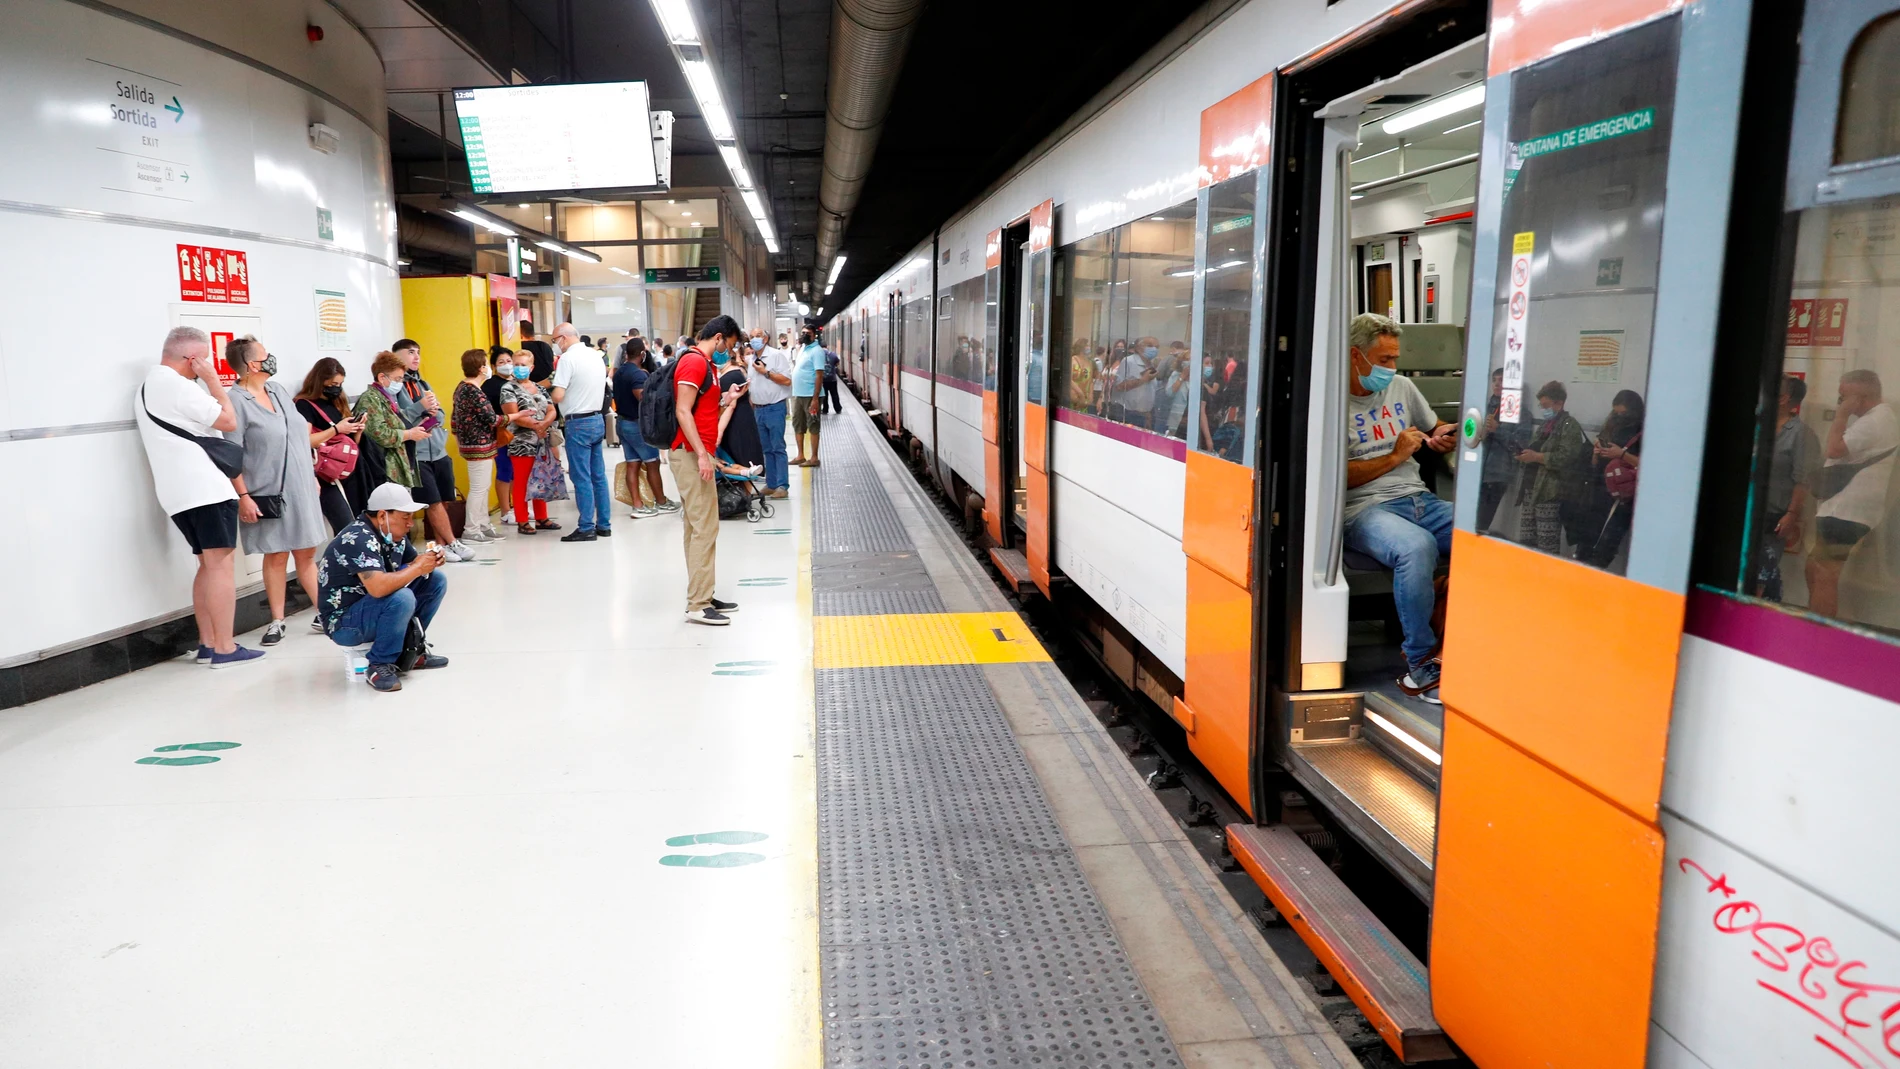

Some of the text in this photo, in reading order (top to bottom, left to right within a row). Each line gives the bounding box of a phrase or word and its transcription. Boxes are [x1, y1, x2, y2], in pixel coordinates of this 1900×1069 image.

[116, 80, 155, 105] Salida
[507, 88, 540, 97] Sortides
[110, 103, 157, 129] Sortida
[1518, 135, 1560, 158] VENTANA
[1562, 130, 1577, 148] DE
[1578, 111, 1651, 143] EMERGENCIA
[142, 136, 159, 148] EXIT
[137, 161, 161, 172] Ascensor
[137, 172, 162, 183] Ascensor
[182, 289, 203, 297] EXTINTOR
[1355, 402, 1405, 427] STAR
